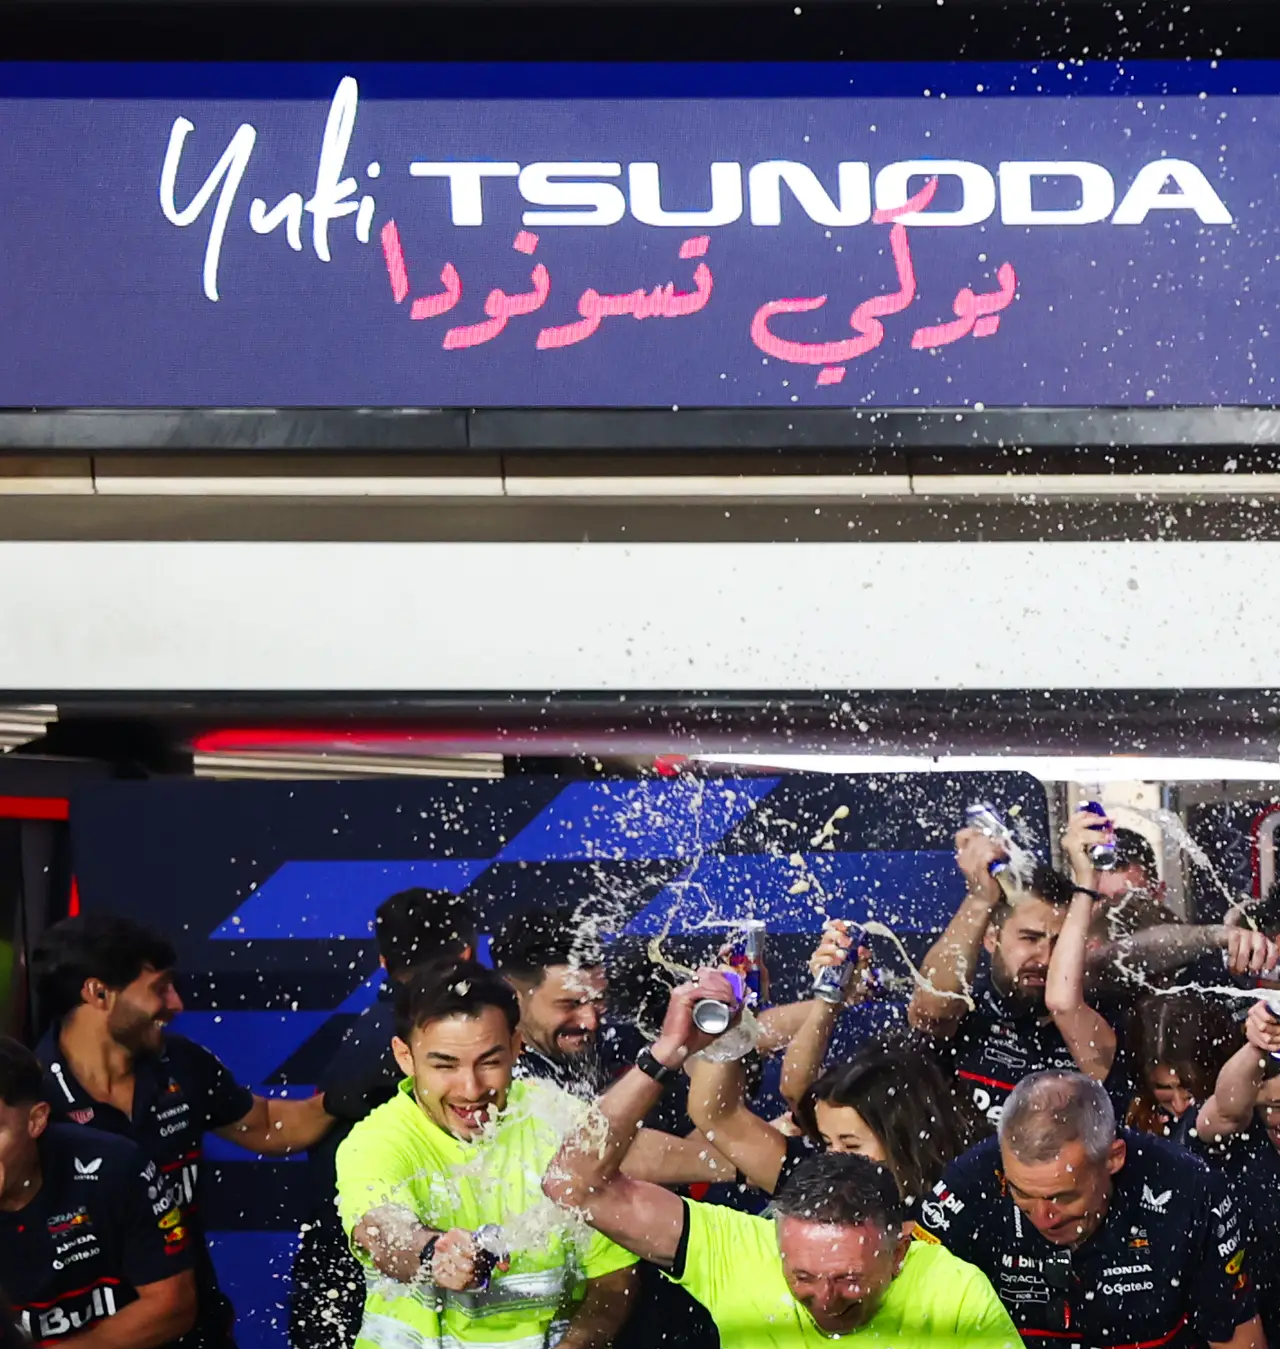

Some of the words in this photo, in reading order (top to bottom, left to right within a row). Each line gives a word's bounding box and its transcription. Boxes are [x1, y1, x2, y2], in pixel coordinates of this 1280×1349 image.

[160, 76, 380, 301] Yuki
[410, 158, 1233, 227] TSUNODA
[380, 218, 713, 350] تسونودا
[751, 175, 1016, 384] يوكي
[1211, 1195, 1233, 1218] VISA
[1103, 1264, 1152, 1277] HONDA
[1114, 1280, 1154, 1294] Gate.io
